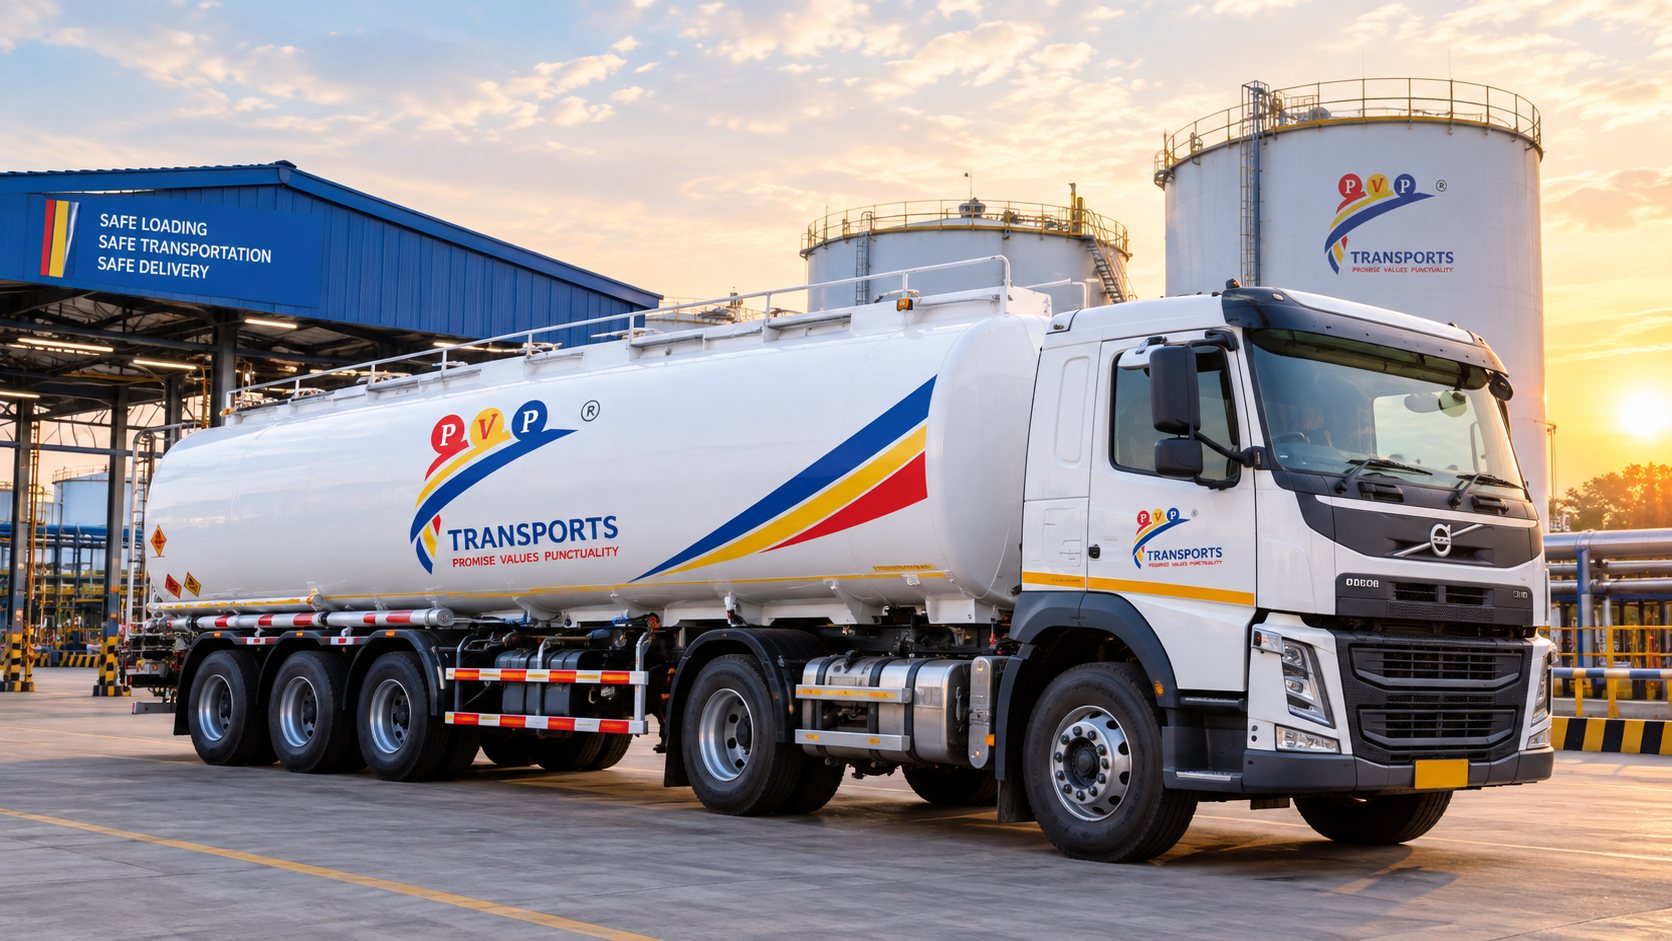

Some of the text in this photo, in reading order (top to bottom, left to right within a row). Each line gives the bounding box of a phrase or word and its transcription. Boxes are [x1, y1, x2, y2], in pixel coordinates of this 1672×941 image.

[99, 213, 208, 236] SAFE LOADING
[98, 234, 272, 264] SAFE TRANSPORTATION
[1350, 251, 1454, 264] TRANSPORTS
[97, 256, 210, 279] SAFE DELIVERY
[447, 515, 619, 551] TRANSPORTS
[452, 546, 619, 568] PROMISE VALUES PUNCTUALITY
[1147, 547, 1223, 561] TRANSPORTS
